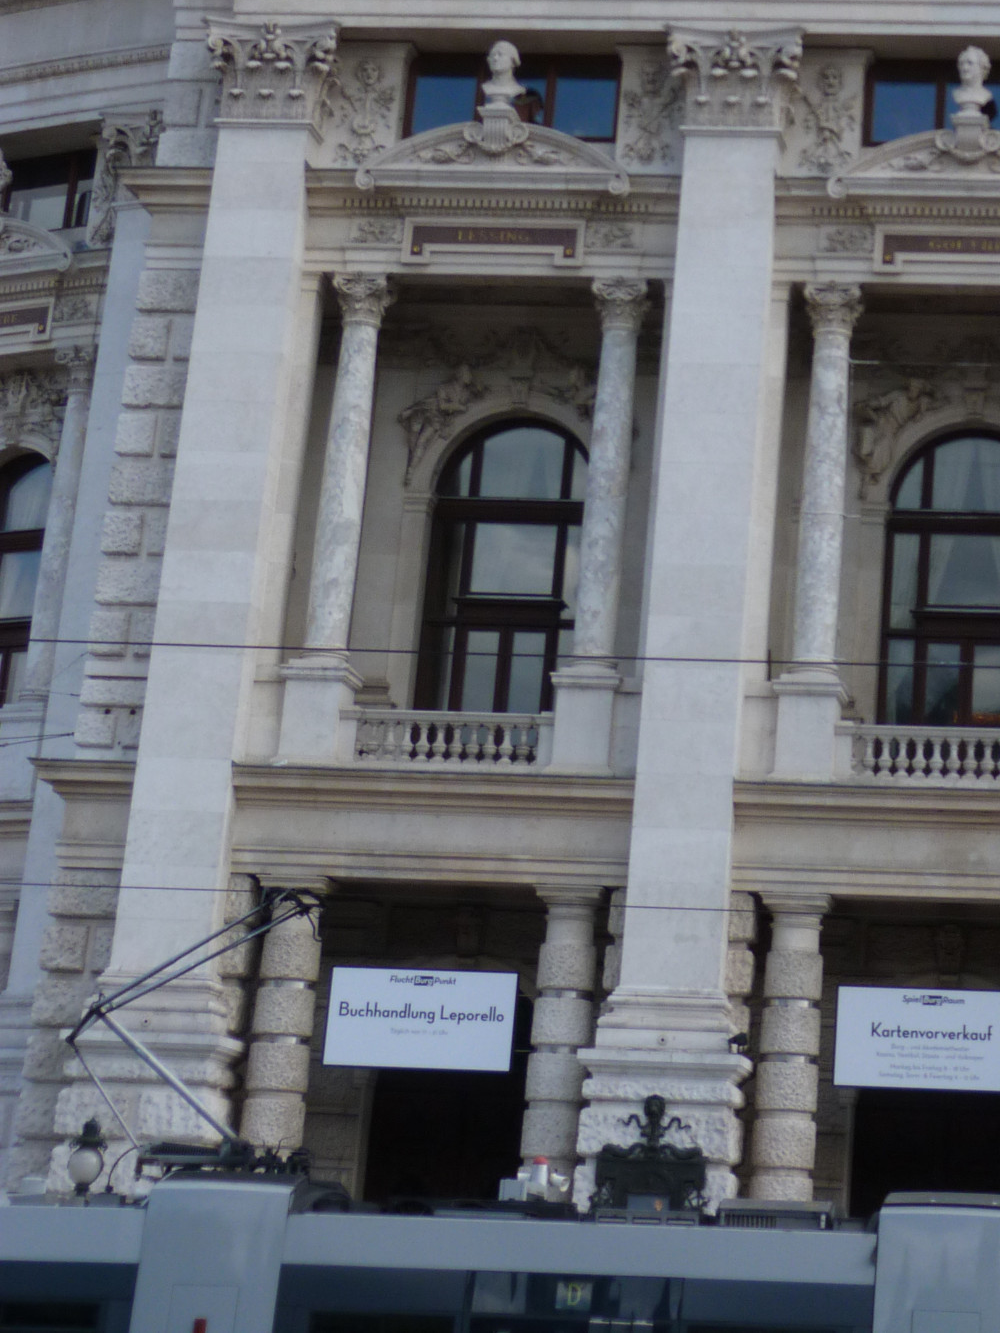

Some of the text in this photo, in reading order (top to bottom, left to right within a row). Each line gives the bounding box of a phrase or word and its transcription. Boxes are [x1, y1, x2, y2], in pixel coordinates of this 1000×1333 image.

[338, 1001, 505, 1025] Buchhandlung Leporello
[870, 1022, 993, 1042] Kartenvorverkauf
[567, 1282, 582, 1306] D
